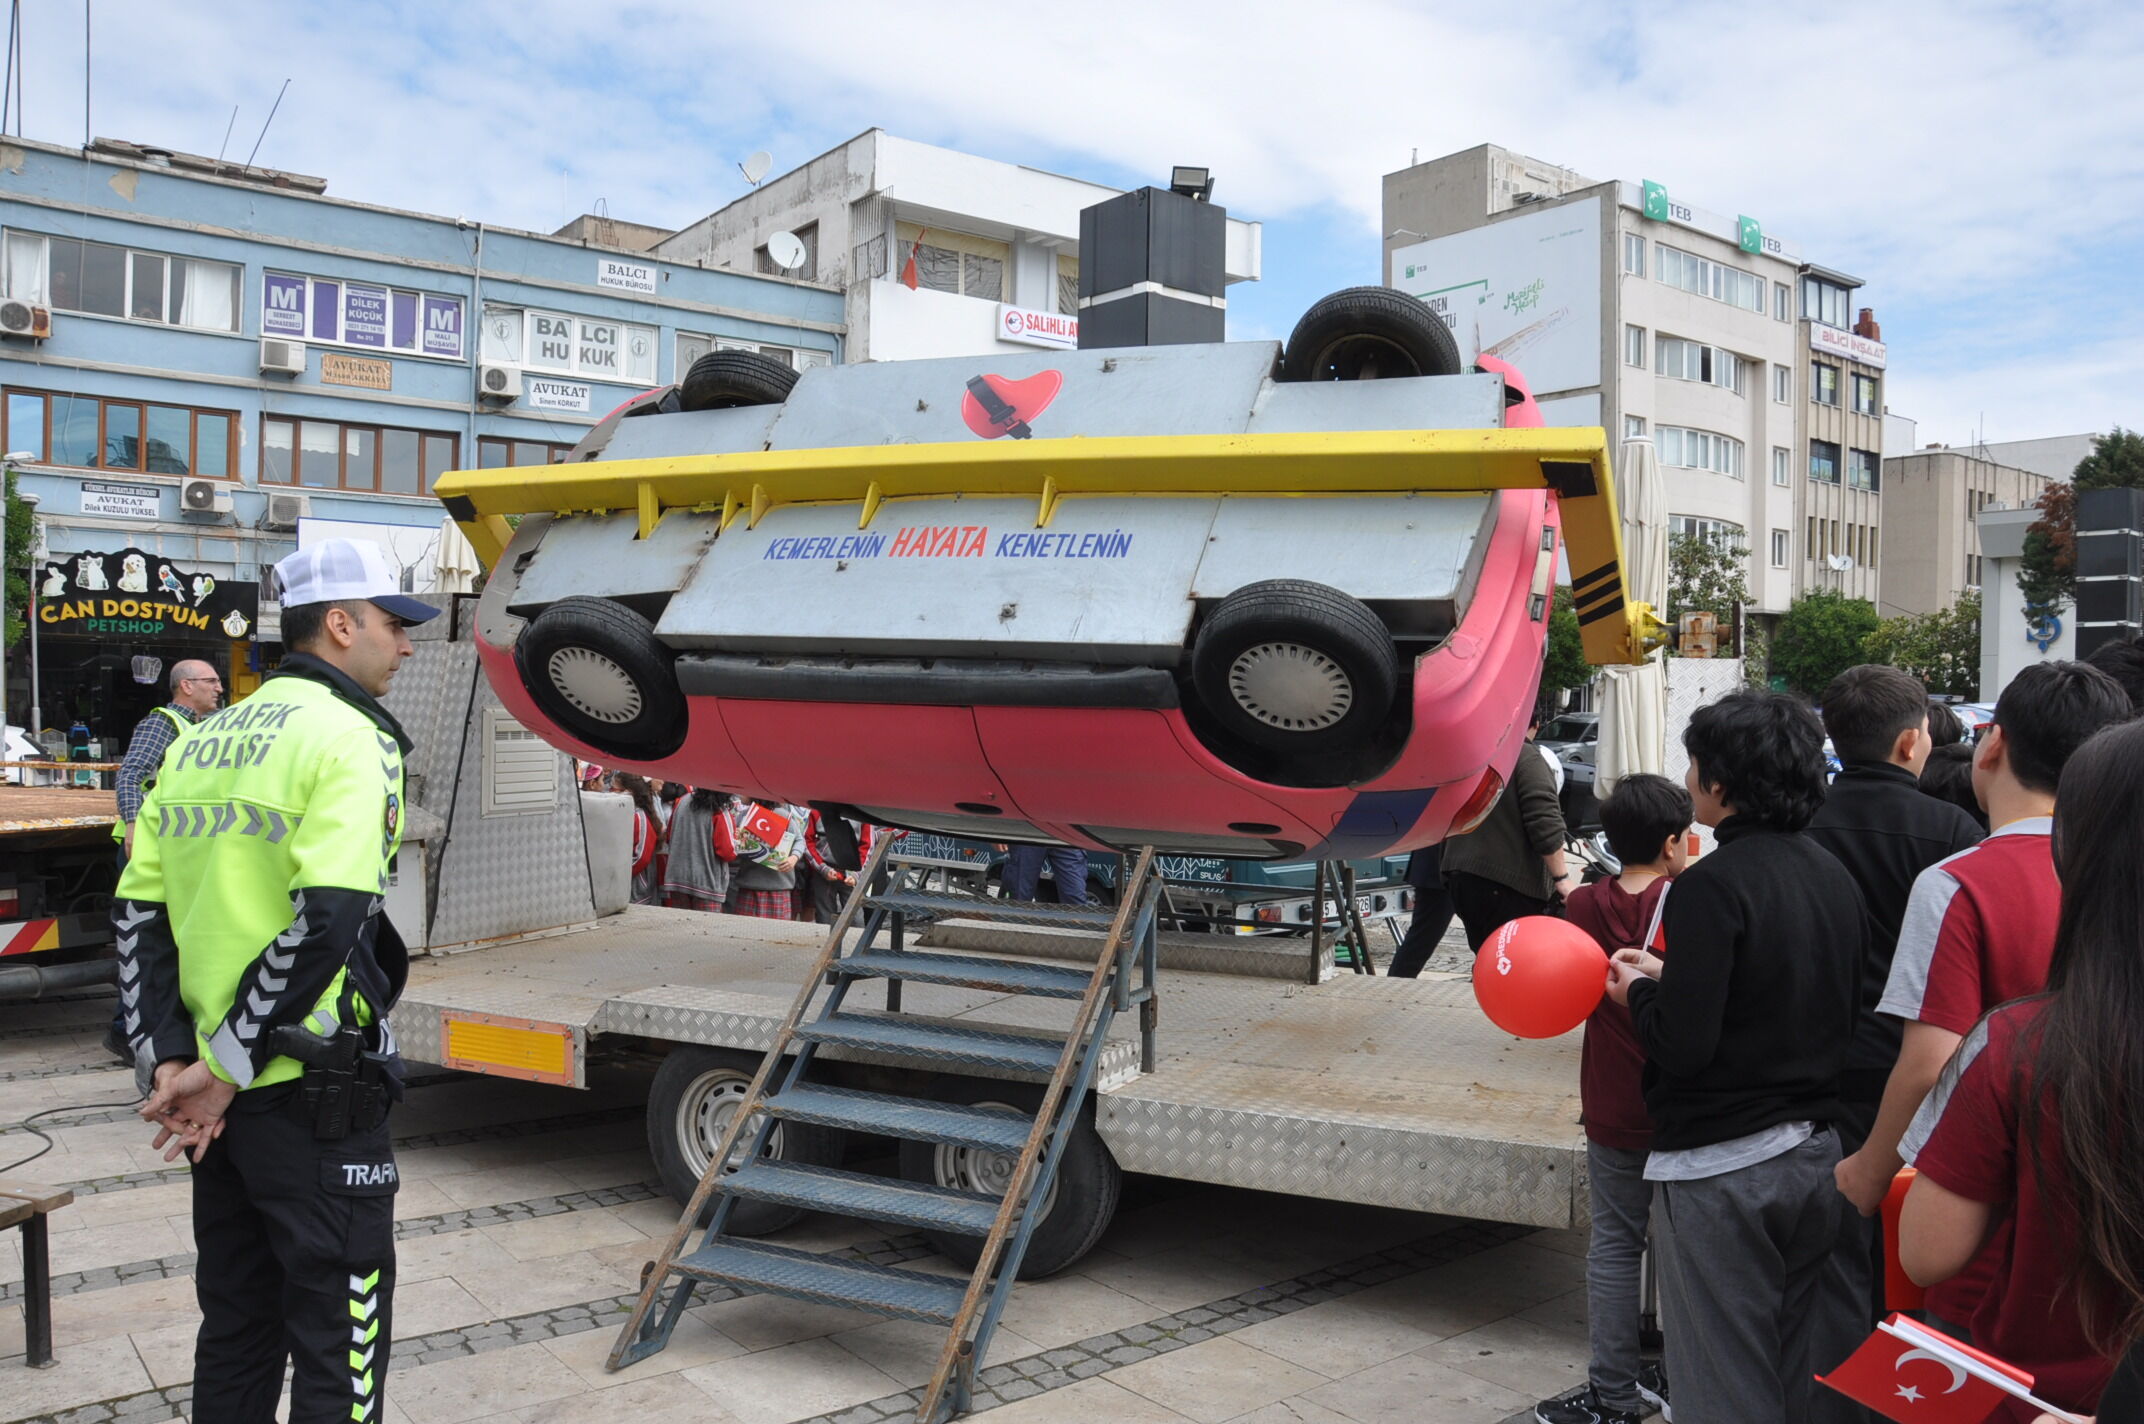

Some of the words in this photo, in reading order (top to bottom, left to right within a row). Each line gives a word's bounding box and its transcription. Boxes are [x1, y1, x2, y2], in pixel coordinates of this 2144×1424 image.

[1668, 202, 1692, 222] TEB
[1761, 235, 1781, 253] TEB
[608, 264, 647, 280] BALCI
[601, 276, 623, 287] HUKUK
[351, 297, 380, 309] DİLEK
[348, 308, 384, 321] KÜÇÜK
[333, 360, 381, 373] AVUKAT
[532, 382, 588, 398] AVUKAT
[538, 397, 556, 406] Sinem
[557, 399, 581, 408] KORKUT
[97, 496, 144, 506] AVUKAT
[84, 504, 101, 512] Dilek
[103, 505, 129, 514] KUZULU
[131, 506, 156, 517] YÜKSEL
[763, 531, 886, 560] KEMERLENİN
[888, 526, 989, 558] HAYATA
[995, 528, 1133, 559] KENETLENİN
[40, 600, 96, 623] CAN
[102, 599, 210, 631] DOST'UM
[87, 619, 165, 634] PETSHOP
